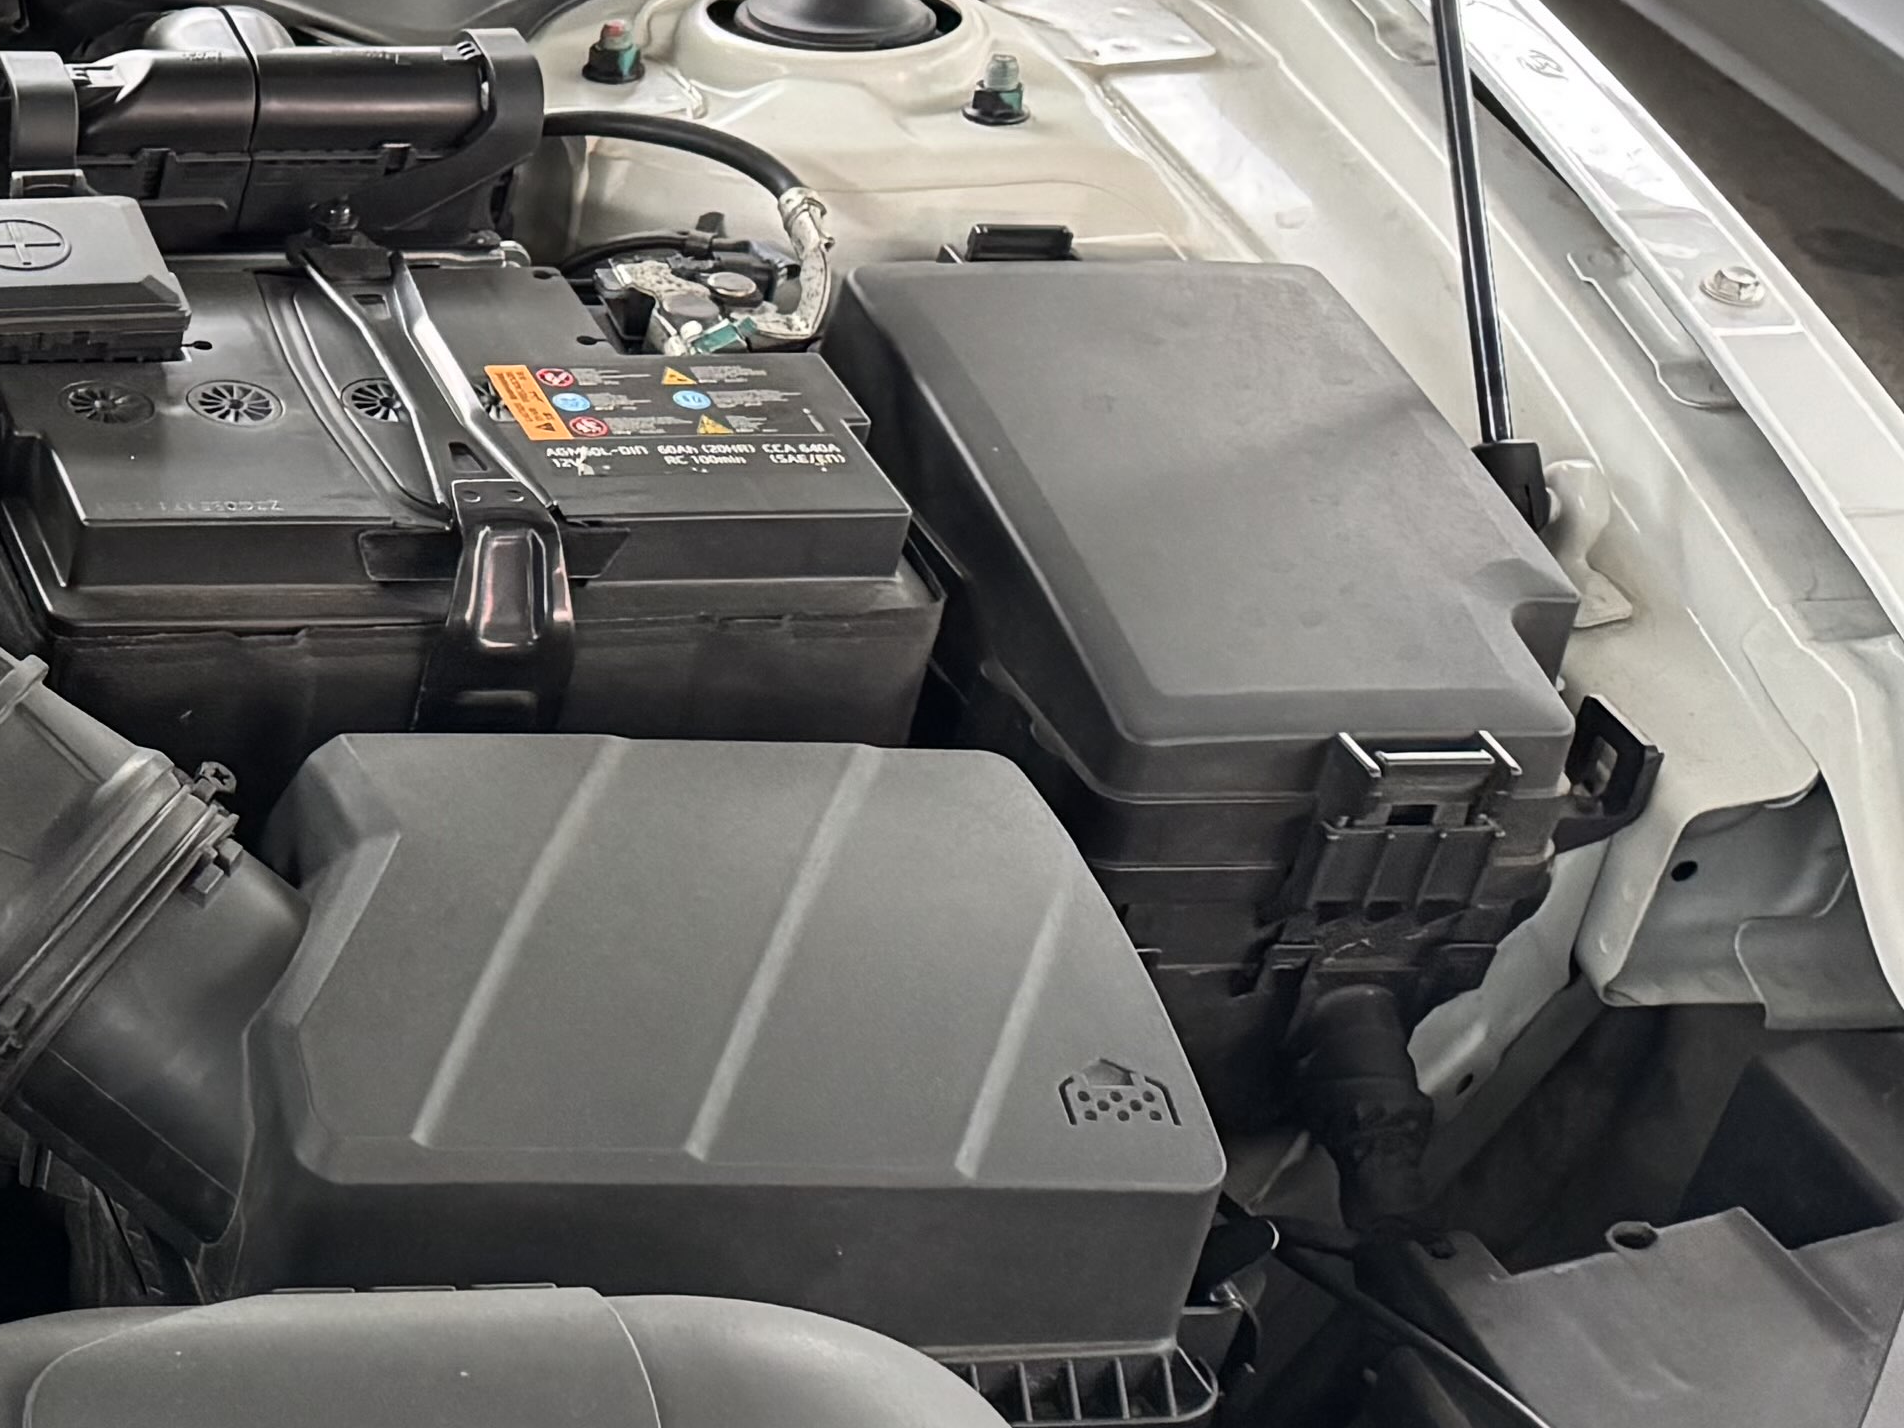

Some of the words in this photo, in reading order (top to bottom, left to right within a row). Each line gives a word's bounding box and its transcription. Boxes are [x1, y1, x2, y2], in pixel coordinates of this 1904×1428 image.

[761, 443, 796, 454] CCA
[798, 443, 842, 454] 640A
[665, 455, 687, 465] RC
